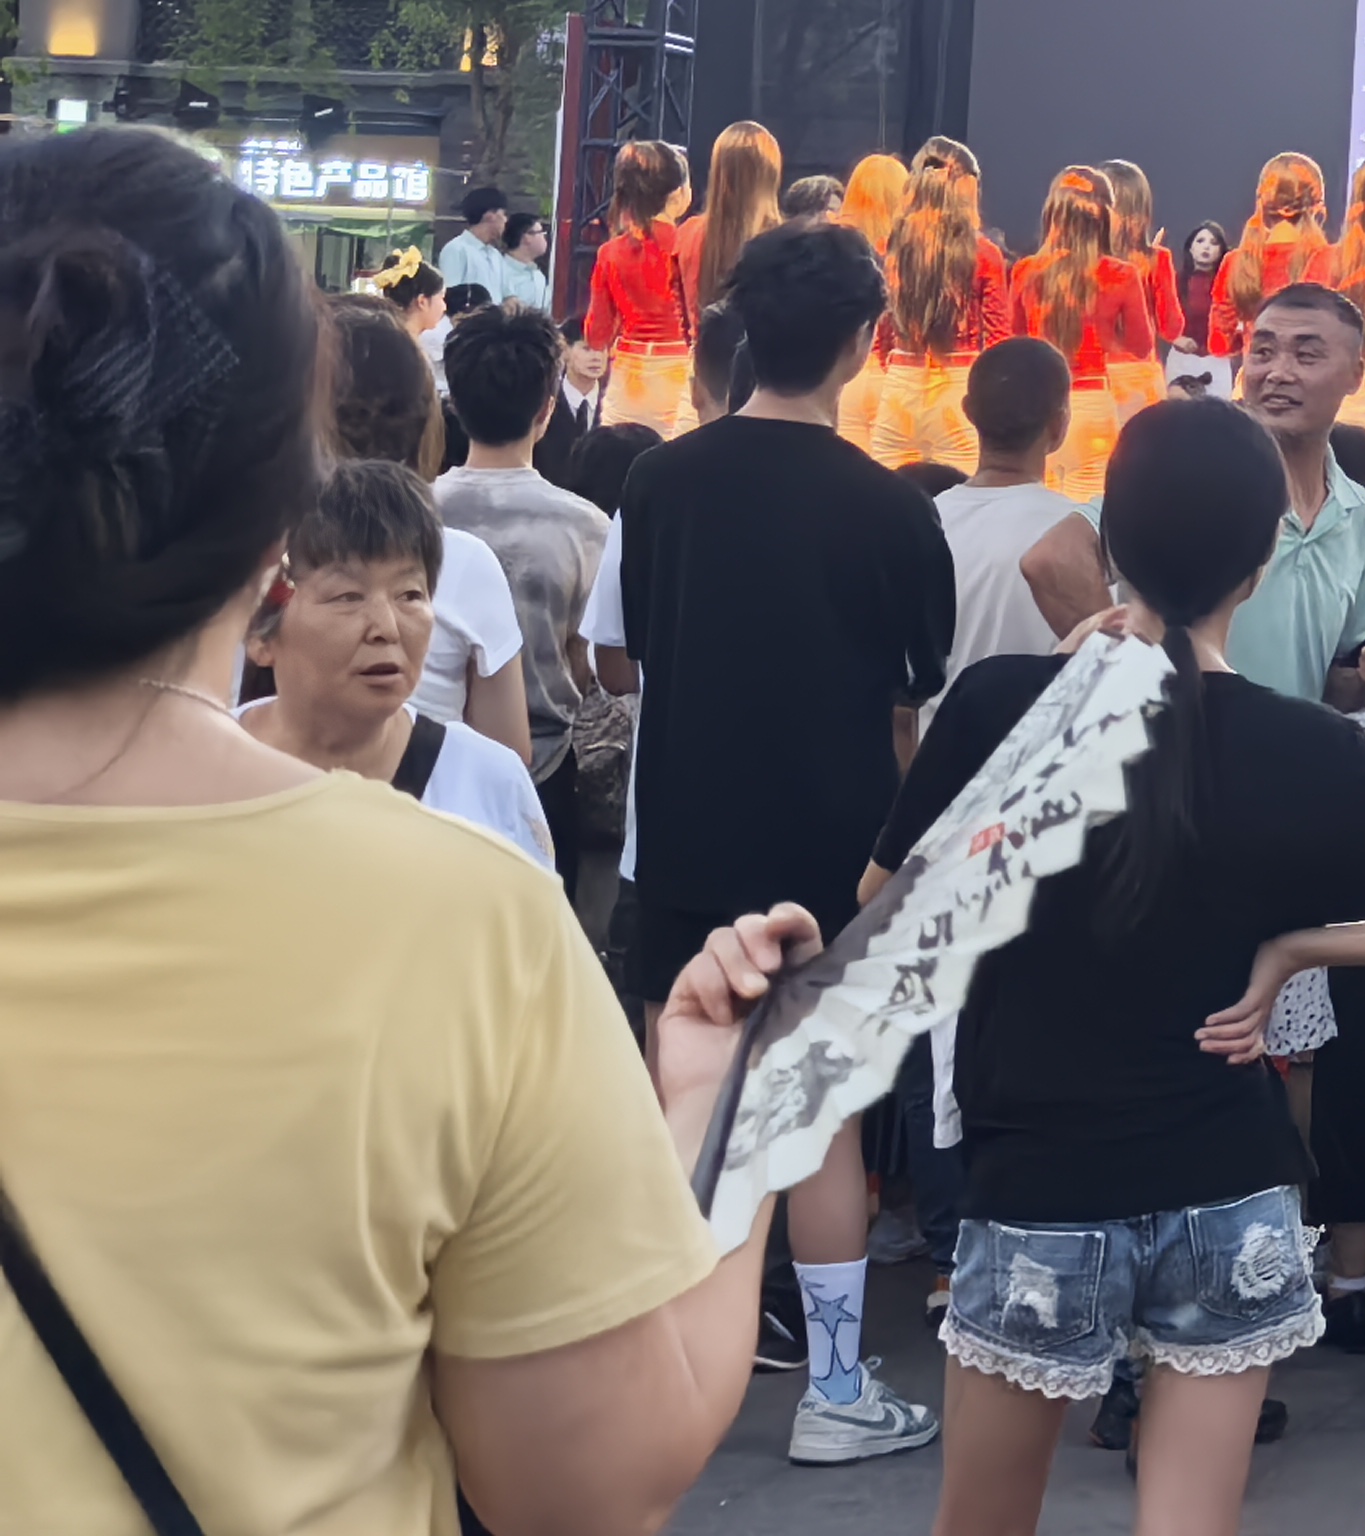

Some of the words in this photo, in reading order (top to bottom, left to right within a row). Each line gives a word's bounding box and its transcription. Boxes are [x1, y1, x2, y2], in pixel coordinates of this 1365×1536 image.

[241, 157, 430, 202] 特色产品馆
